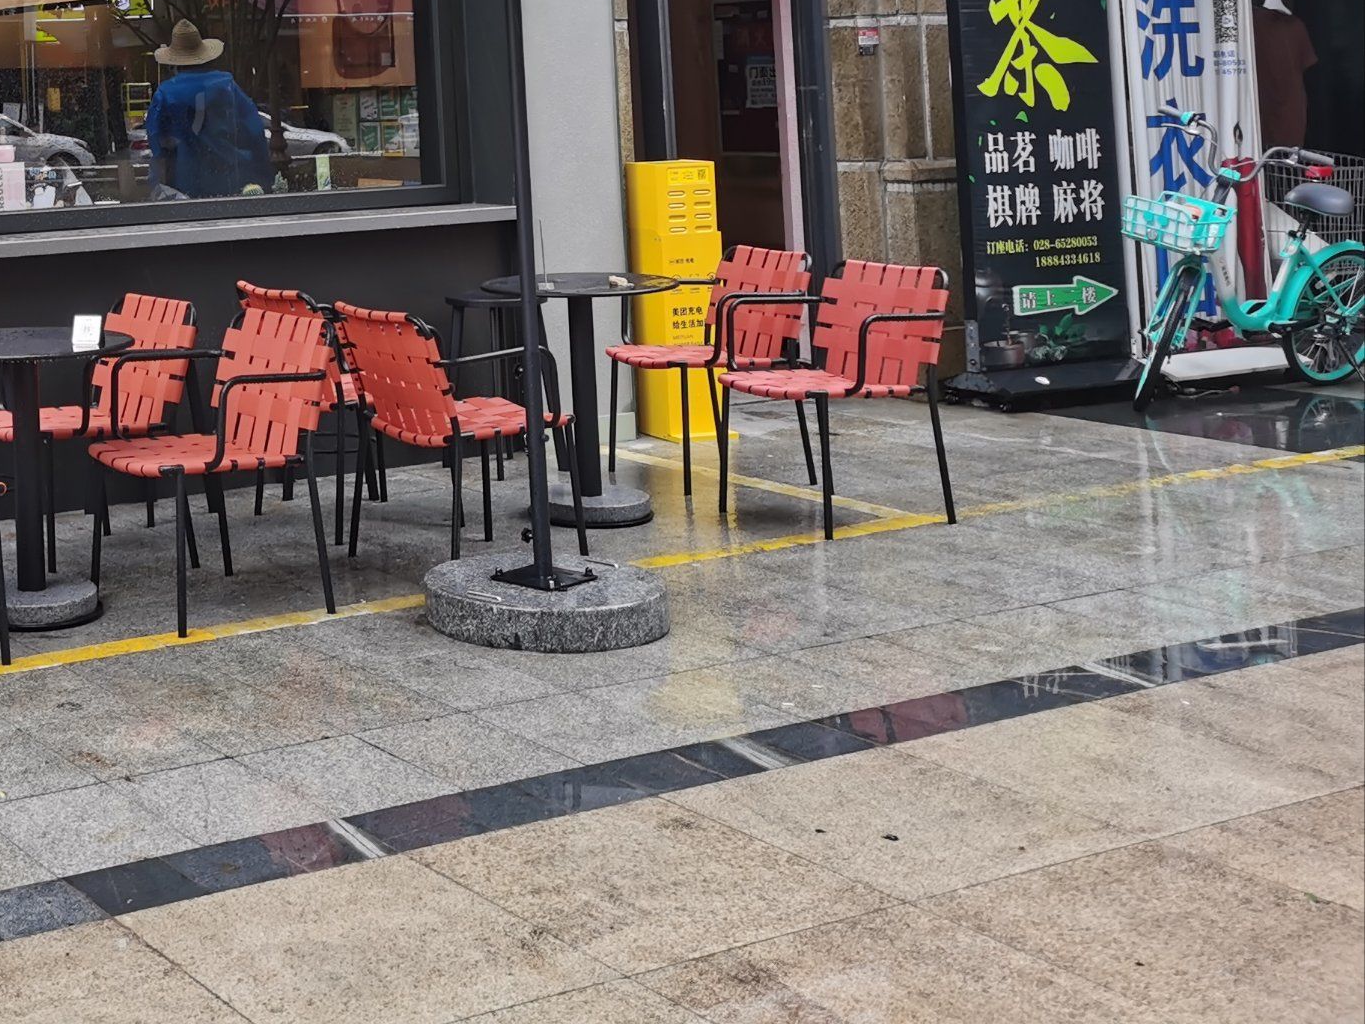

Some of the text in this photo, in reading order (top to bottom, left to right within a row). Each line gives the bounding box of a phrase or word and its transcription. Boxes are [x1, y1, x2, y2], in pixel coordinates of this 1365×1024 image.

[984, 127, 1102, 174] 品茗 咖啡
[985, 179, 1106, 228] 棋牌 麻将
[1033, 235, 1098, 251] 028-65280053
[1035, 251, 1102, 269] 18884334618
[672, 306, 704, 317] 美团充电
